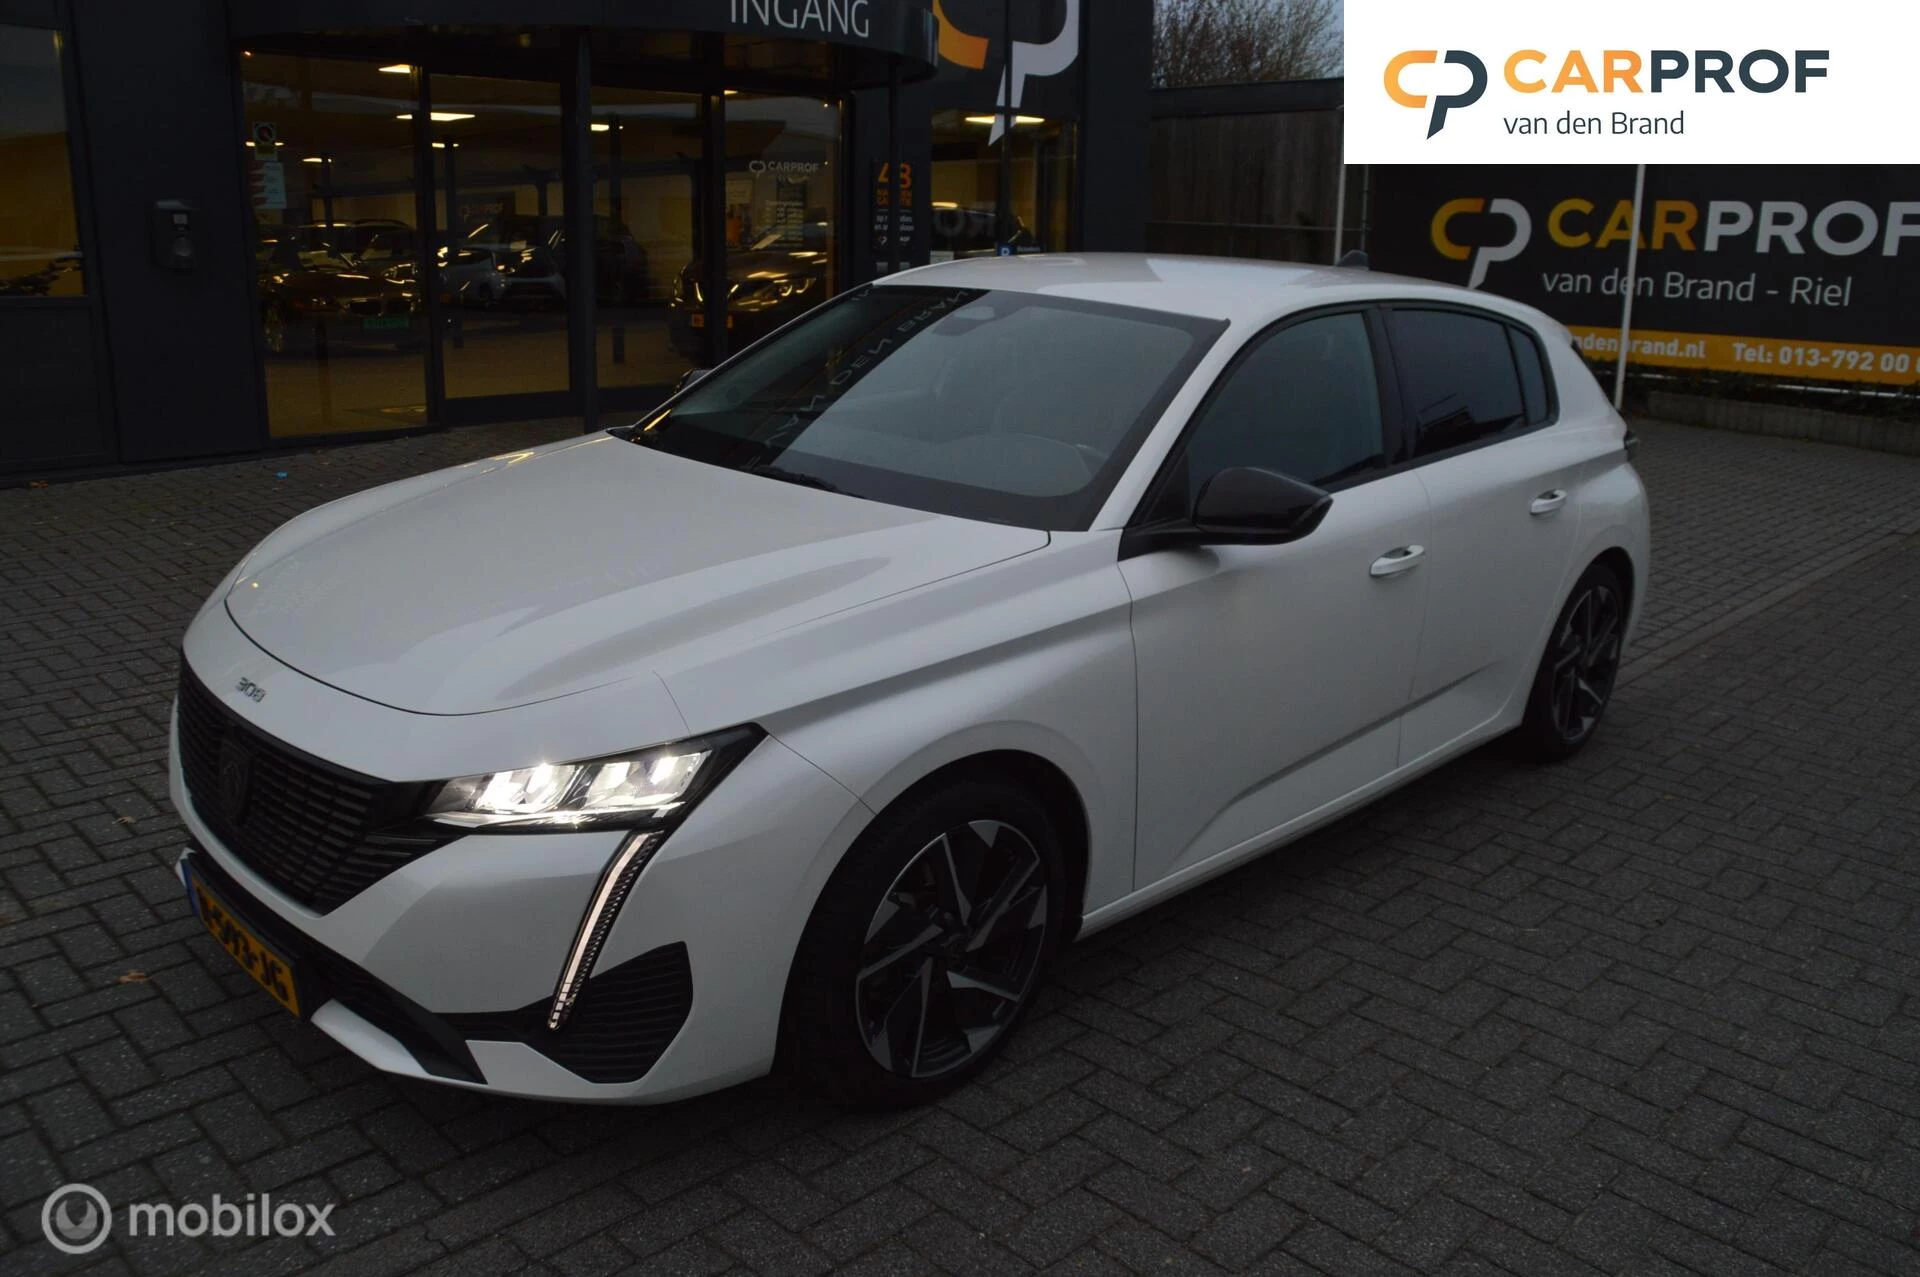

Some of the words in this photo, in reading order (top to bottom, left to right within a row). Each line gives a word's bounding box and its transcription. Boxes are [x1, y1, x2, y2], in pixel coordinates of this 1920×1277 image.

[729, 0, 869, 38] INGANG
[767, 160, 820, 173] CARPROF
[1546, 196, 1920, 257] CARPROF
[1541, 271, 1593, 296] van
[1600, 268, 1655, 298] den
[1663, 271, 1757, 303] Brand
[1788, 275, 1853, 307] Riel
[1732, 342, 1774, 364] Tel:
[1778, 346, 1874, 372] 013-792
[1879, 352, 1911, 374] 00
[235, 676, 266, 703] 308
